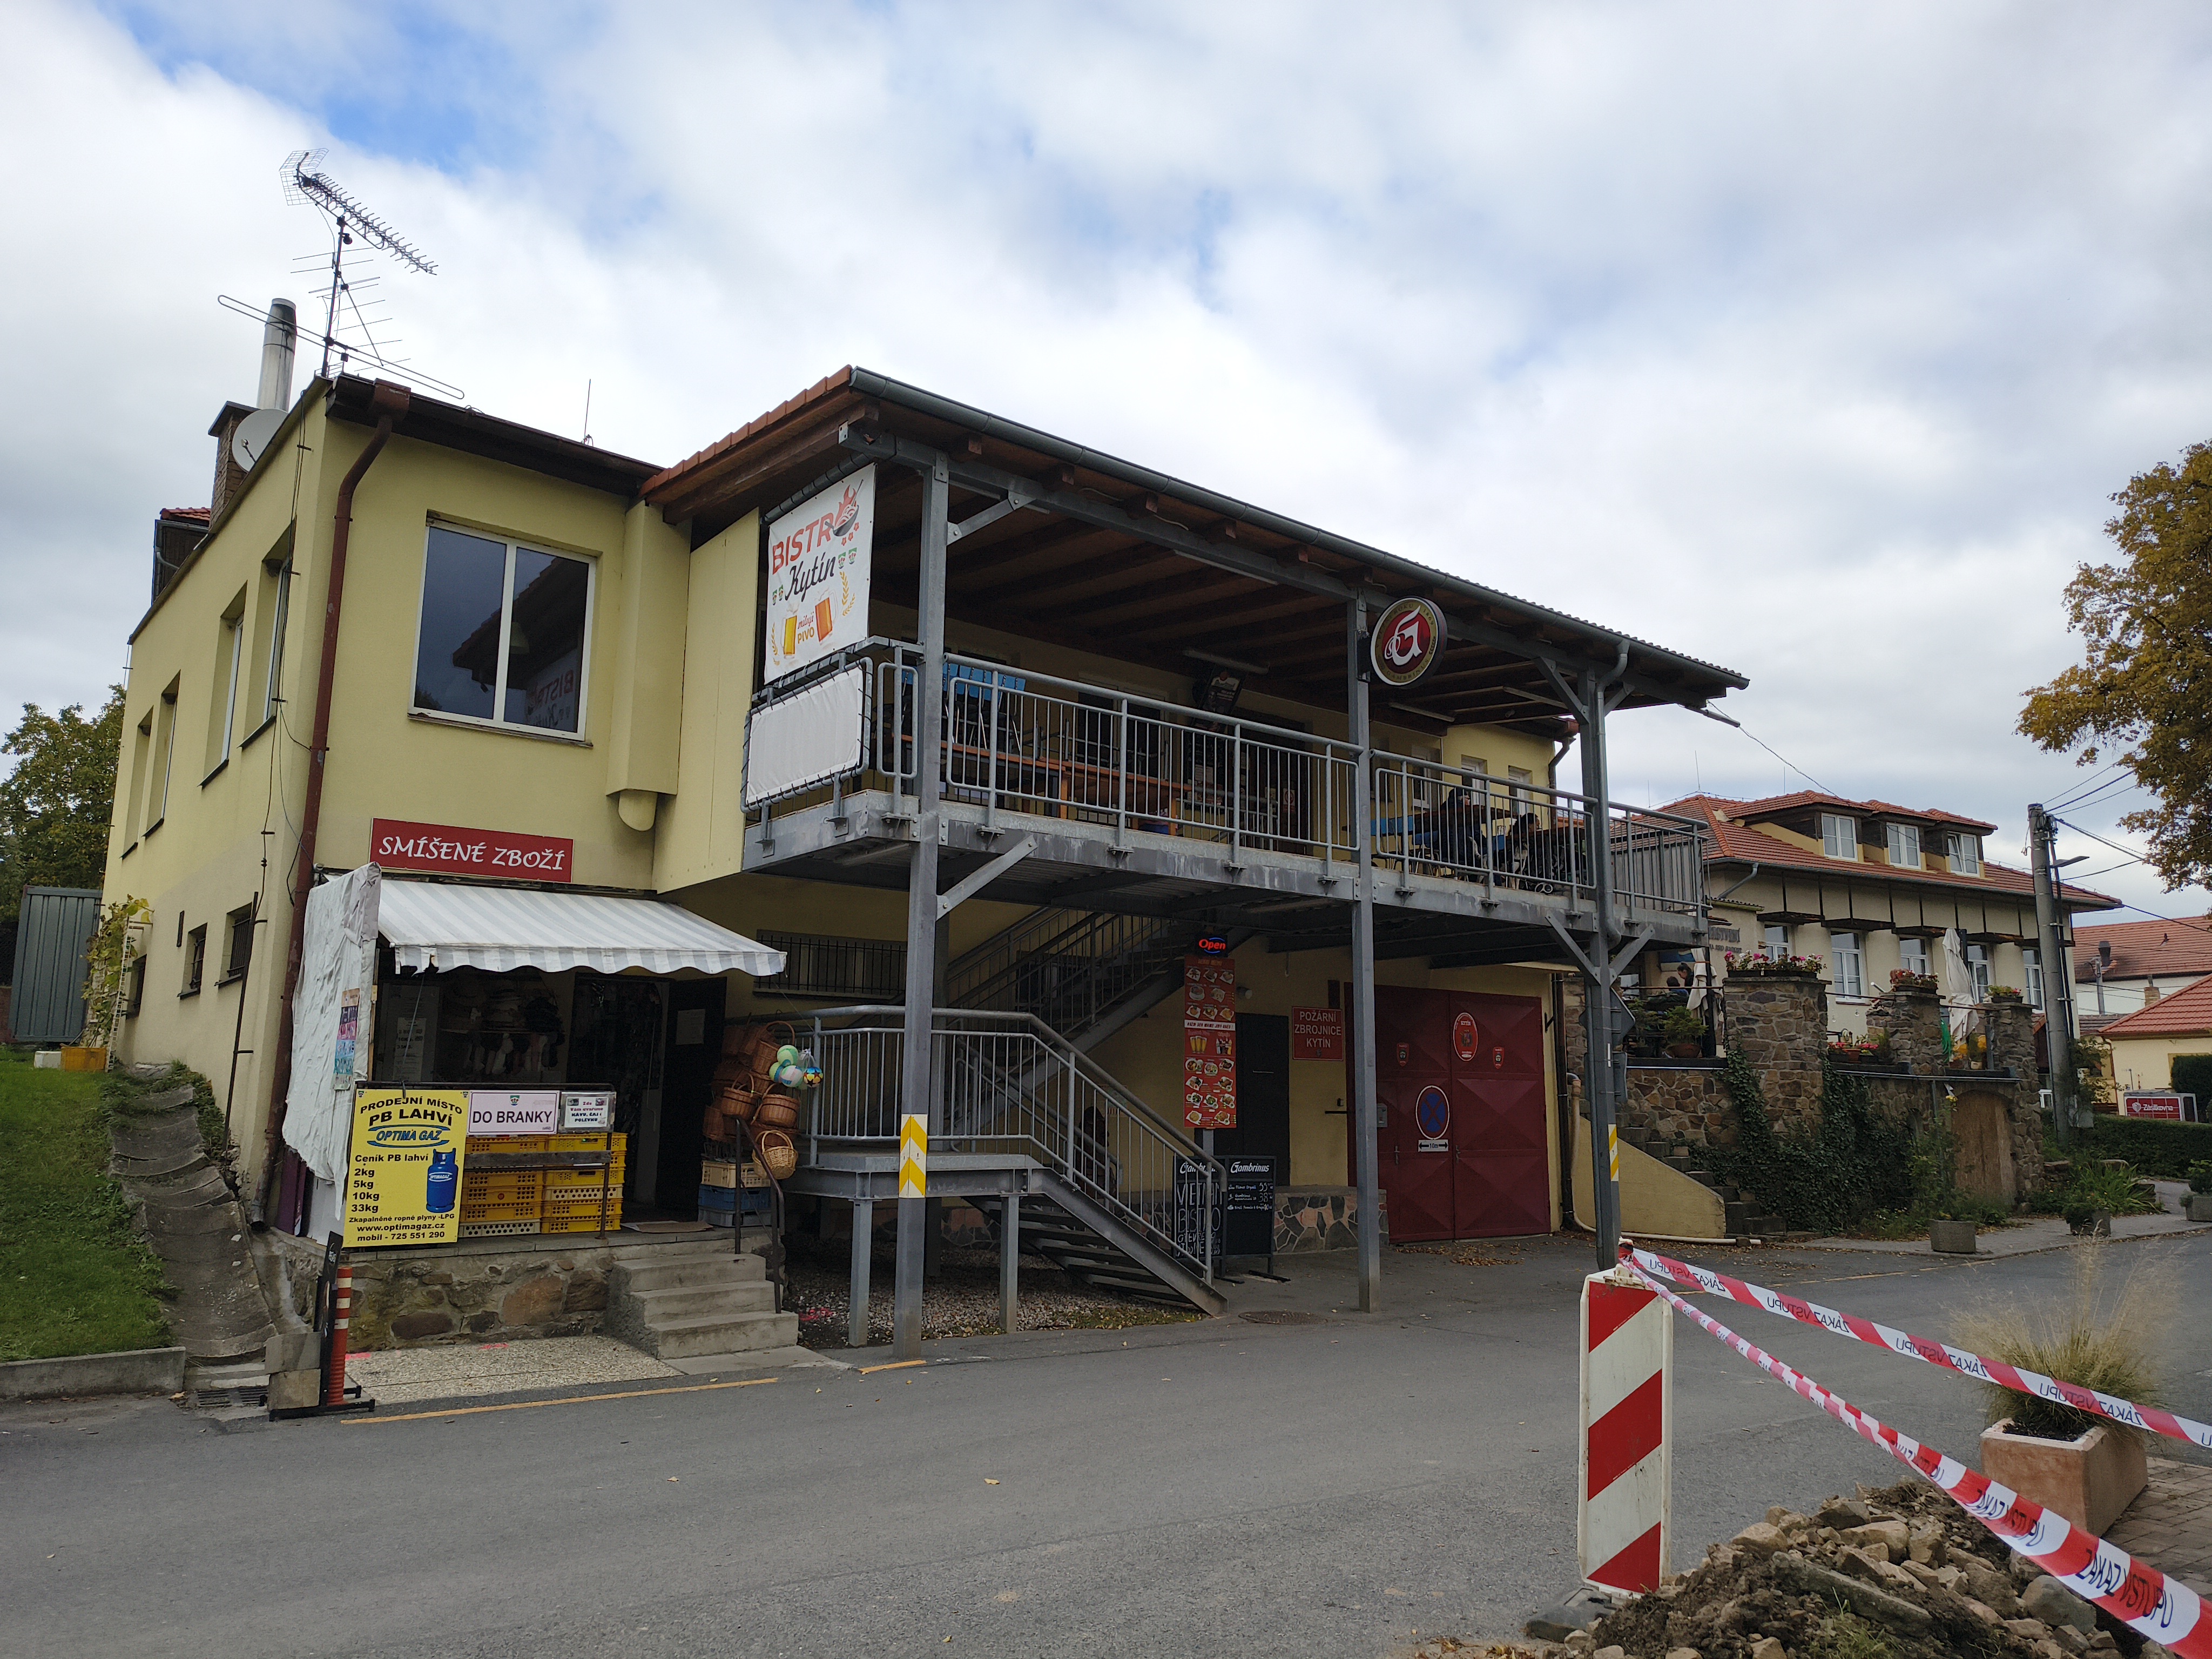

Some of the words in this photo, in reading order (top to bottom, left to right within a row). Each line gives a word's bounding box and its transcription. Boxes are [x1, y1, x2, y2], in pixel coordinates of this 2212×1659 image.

[785, 551, 836, 602] Kytín
[798, 626, 814, 644] PIVO
[379, 836, 487, 862] SMÍŠENÉ
[491, 847, 565, 871] ZBOŽÍ
[1198, 939, 1226, 950] Open
[1299, 1010, 1336, 1022] POŽÁRNÍ
[1294, 1024, 1341, 1035] ZBROJNICE
[1306, 1036, 1331, 1048] KYTÍN
[360, 1096, 423, 1114] PRODEJNÍ
[427, 1098, 462, 1114] MÍSTO
[369, 1111, 392, 1127] PB
[399, 1109, 453, 1126] LAHVÍ
[472, 1110, 493, 1123] DO
[496, 1110, 552, 1123] BRANKY
[376, 1130, 416, 1141] OPTIMA
[419, 1130, 442, 1141] GAZ
[355, 1154, 384, 1162] Ceník
[354, 1168, 375, 1177] 2kg
[1230, 1161, 1270, 1173] Gambrinus
[353, 1180, 374, 1189] 5kg
[353, 1192, 380, 1201] 10kg
[351, 1204, 379, 1213] 33kg
[357, 1223, 445, 1232] www.optimagaz.cz
[2119, 1568, 2174, 1628] VSTUPU
